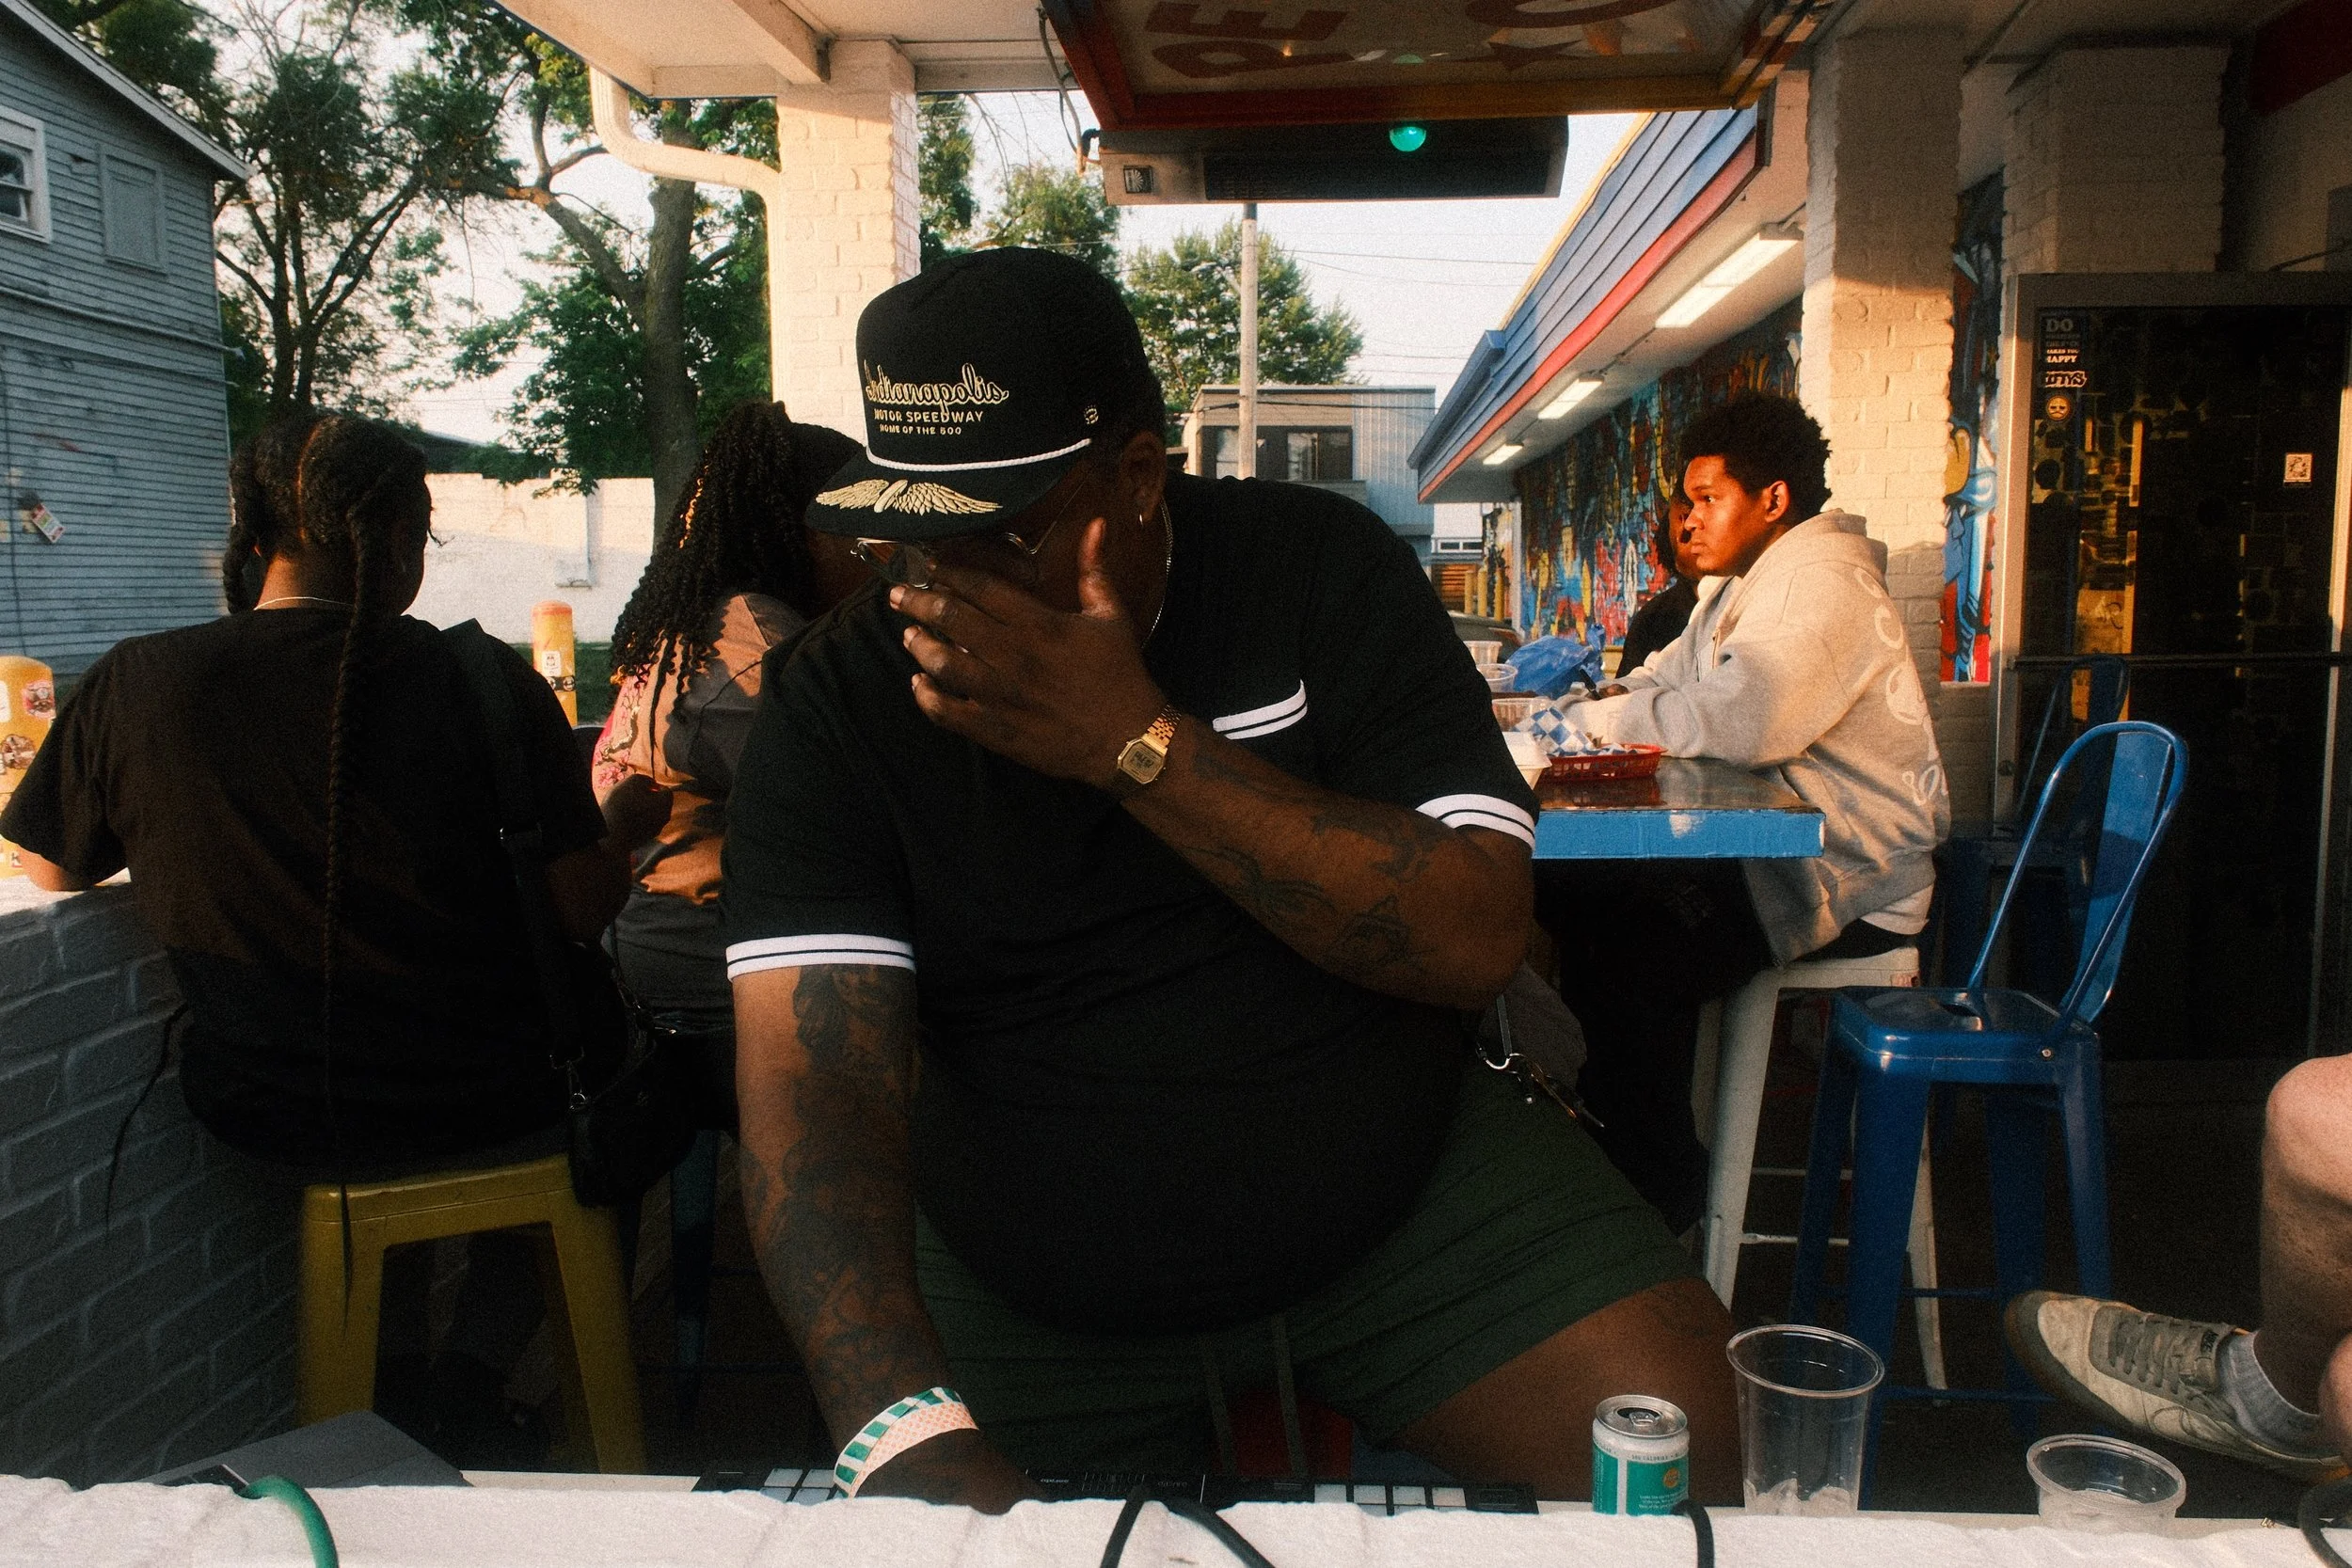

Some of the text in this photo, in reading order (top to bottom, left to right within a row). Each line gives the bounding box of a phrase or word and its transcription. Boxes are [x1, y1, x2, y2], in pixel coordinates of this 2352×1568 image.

[2046, 319, 2074, 332] DO
[863, 358, 1009, 416] Indianapolis
[2045, 371, 2087, 388] ITTYS
[874, 408, 984, 424] MOTOR SPEEDWAY
[880, 423, 962, 436] HOME OF THE 500
